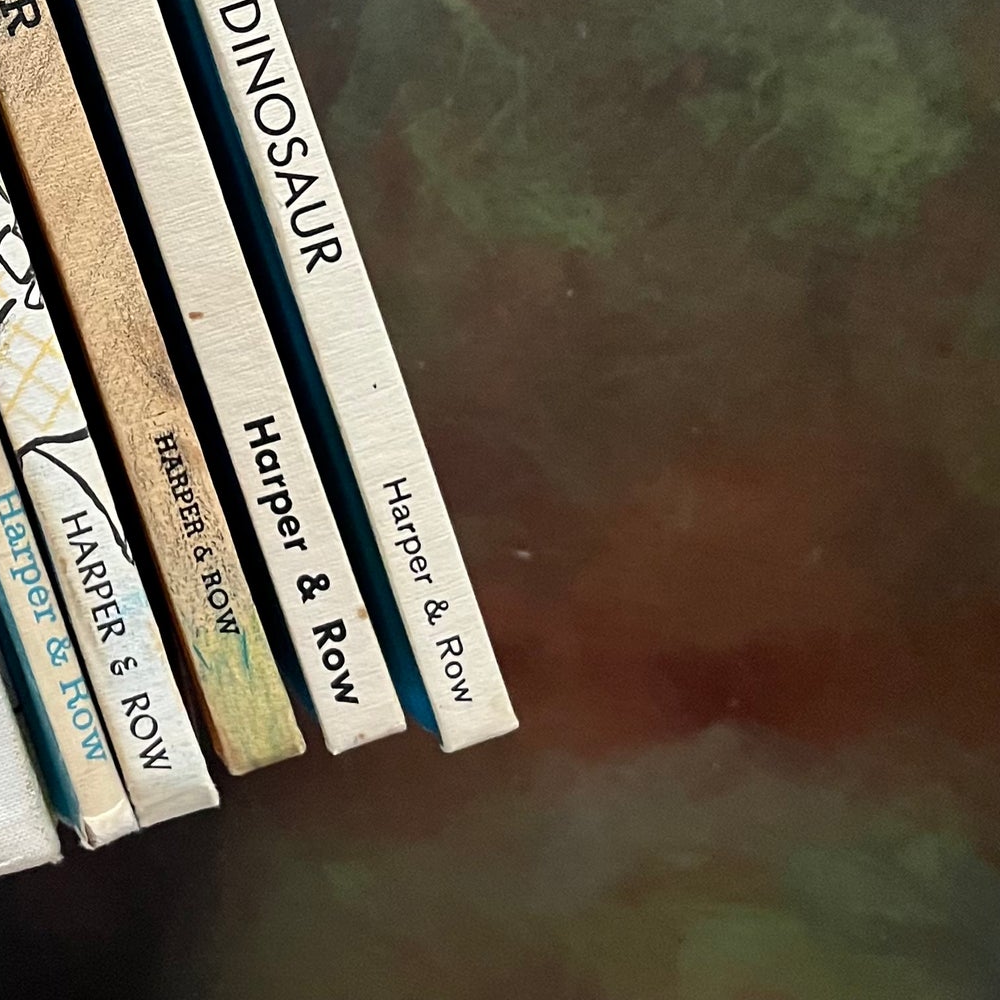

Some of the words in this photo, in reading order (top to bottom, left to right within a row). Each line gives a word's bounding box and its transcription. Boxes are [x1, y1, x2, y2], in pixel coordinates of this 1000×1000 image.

[153, 430, 205, 538] HARPER
[242, 413, 308, 553] Harper
[193, 545, 214, 564] &
[382, 476, 434, 586] Harper
[61, 510, 126, 644] HARPER
[201, 568, 240, 636] ROW
[295, 572, 331, 604] &
[423, 599, 450, 626] &
[45, 633, 73, 667] &
[60, 675, 107, 764] Row
[109, 656, 138, 676] &
[312, 618, 360, 707] Row
[435, 634, 474, 705] Row
[121, 691, 173, 771] ROW
